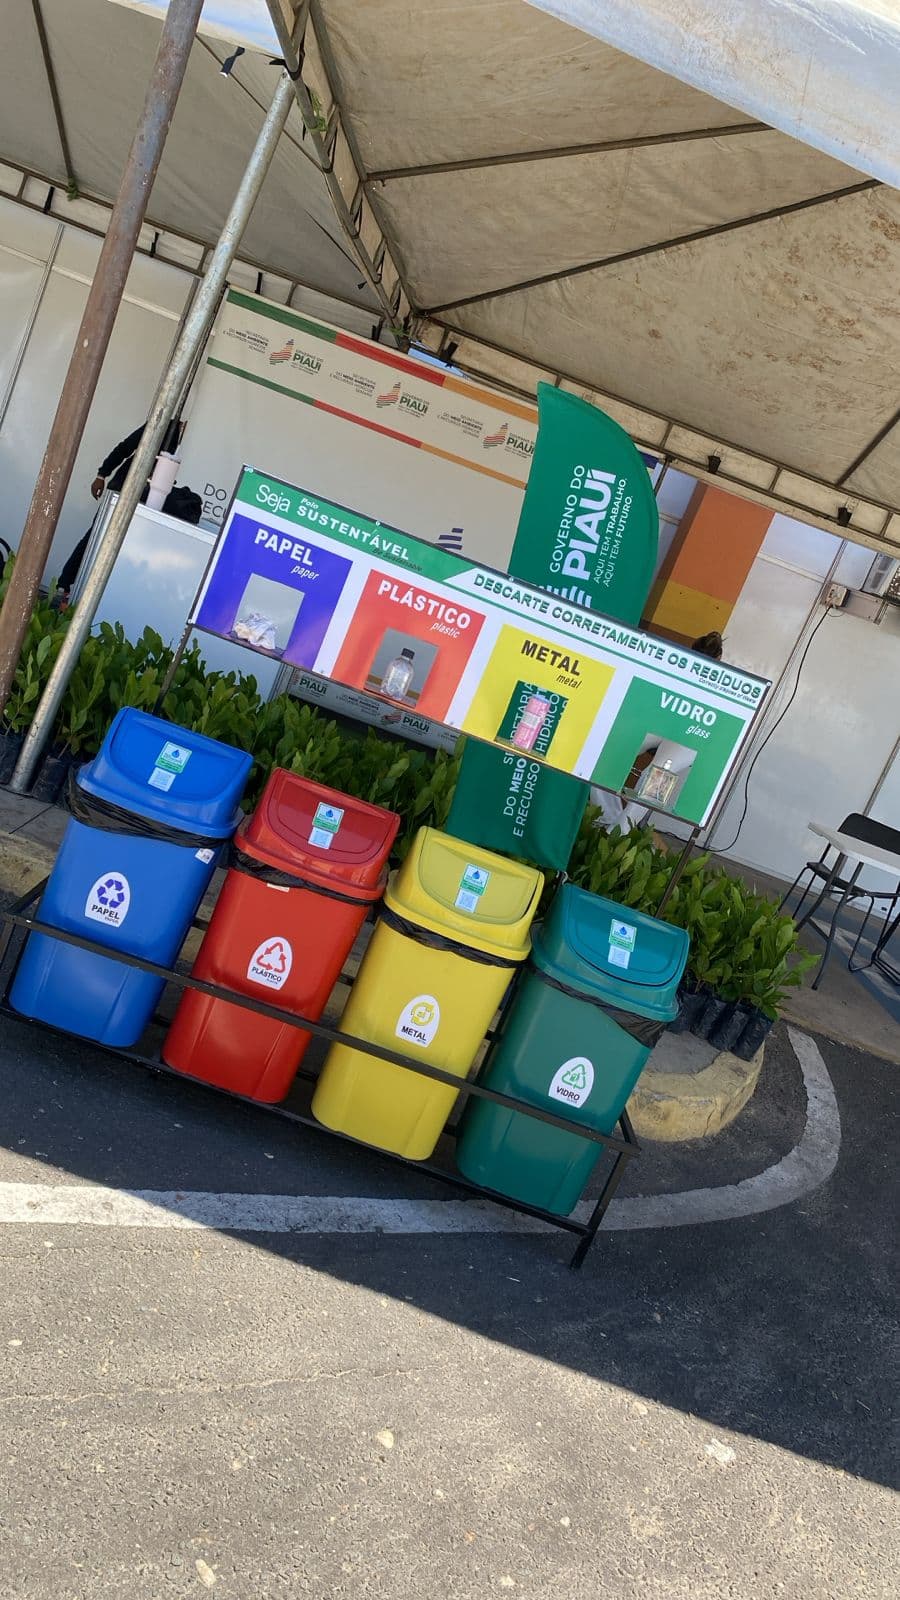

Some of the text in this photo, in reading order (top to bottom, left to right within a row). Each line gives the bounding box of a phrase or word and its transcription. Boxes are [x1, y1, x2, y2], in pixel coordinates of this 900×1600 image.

[203, 482, 227, 501] DO
[255, 483, 291, 513] Seja
[296, 505, 410, 561] SUSTENTÁVEL
[549, 465, 585, 573] GOVERNO DO
[561, 468, 617, 580] PIAUÍ
[593, 478, 628, 584] AQUI TEM TRABALHO.
[254, 528, 314, 567] PAPEL
[602, 495, 634, 587] AQUI TEM FUTURO.
[290, 564, 320, 581] paper
[376, 579, 472, 630] PLÁSTICO
[430, 621, 461, 639] plastic
[473, 573, 761, 699] DESCARTE CORRETAMENTE OS RESÍDUOS
[520, 639, 581, 676] METAL
[555, 673, 583, 690] metal
[535, 693, 560, 754] HIDRICO
[659, 690, 718, 727] VIDRO
[685, 725, 711, 739] glass
[503, 758, 528, 816] DO MEIO
[515, 762, 541, 827] RECURSO
[512, 826, 524, 838] E
[91, 904, 120, 920] PAPEL
[251, 966, 282, 982] PLÁSTICO
[401, 1025, 427, 1041] METAL
[556, 1086, 580, 1101] VIDRO
